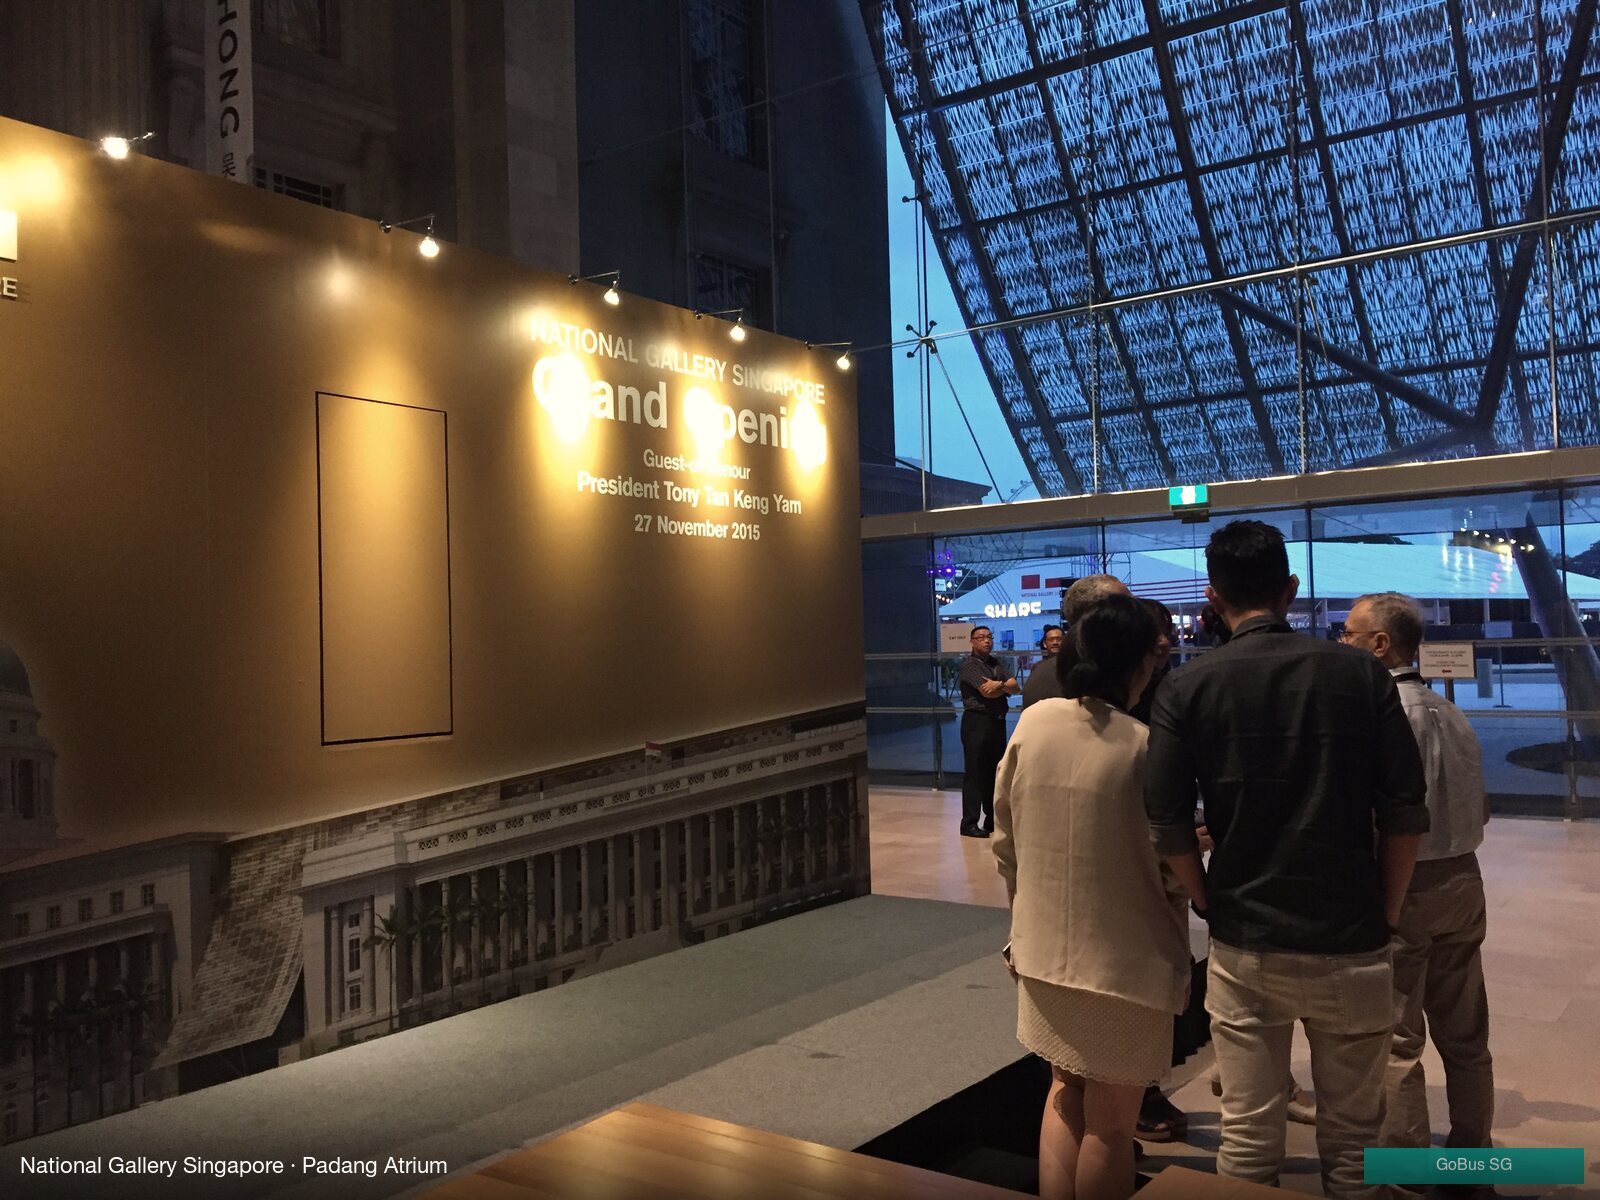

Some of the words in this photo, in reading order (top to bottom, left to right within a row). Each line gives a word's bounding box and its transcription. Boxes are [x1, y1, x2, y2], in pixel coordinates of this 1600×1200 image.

[530, 318, 638, 363] NATIONAL
[646, 343, 727, 382] GALLERY
[732, 364, 826, 405] SINGAPORE
[532, 354, 667, 429] Gand
[577, 470, 659, 499] President
[663, 481, 700, 507] Tony
[733, 489, 769, 515] Keng
[773, 494, 802, 515] Yam
[634, 514, 652, 533] 27
[657, 515, 728, 539] November
[731, 522, 761, 541] 2015
